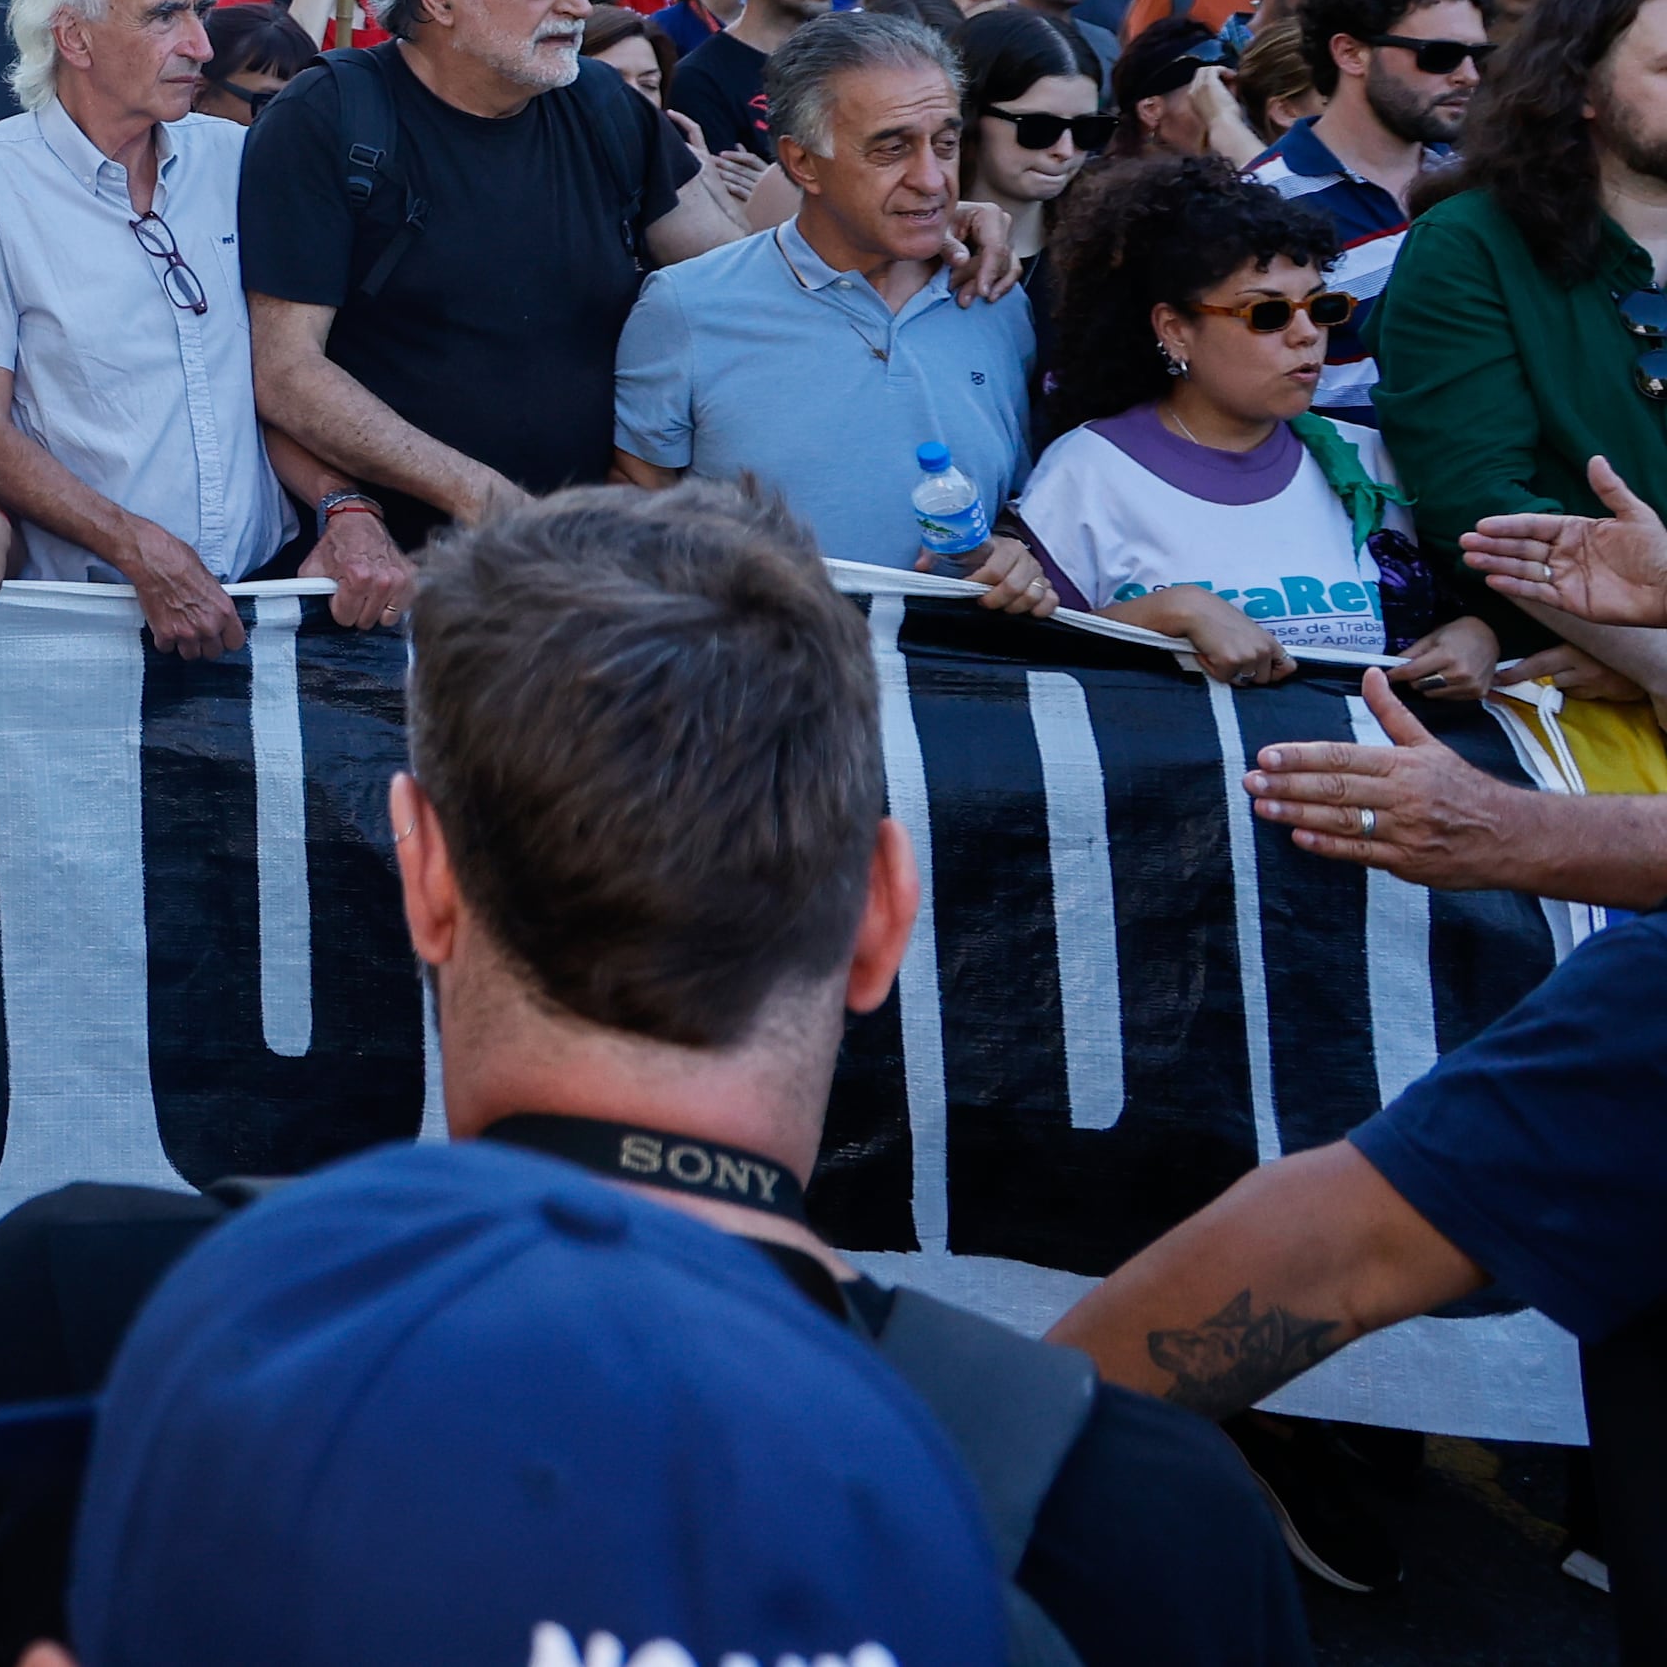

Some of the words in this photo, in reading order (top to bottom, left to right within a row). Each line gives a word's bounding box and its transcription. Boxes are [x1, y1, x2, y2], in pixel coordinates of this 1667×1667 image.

[1305, 622, 1331, 634] de
[1337, 622, 1384, 633] Traba
[619, 1135, 783, 1203] SONY
